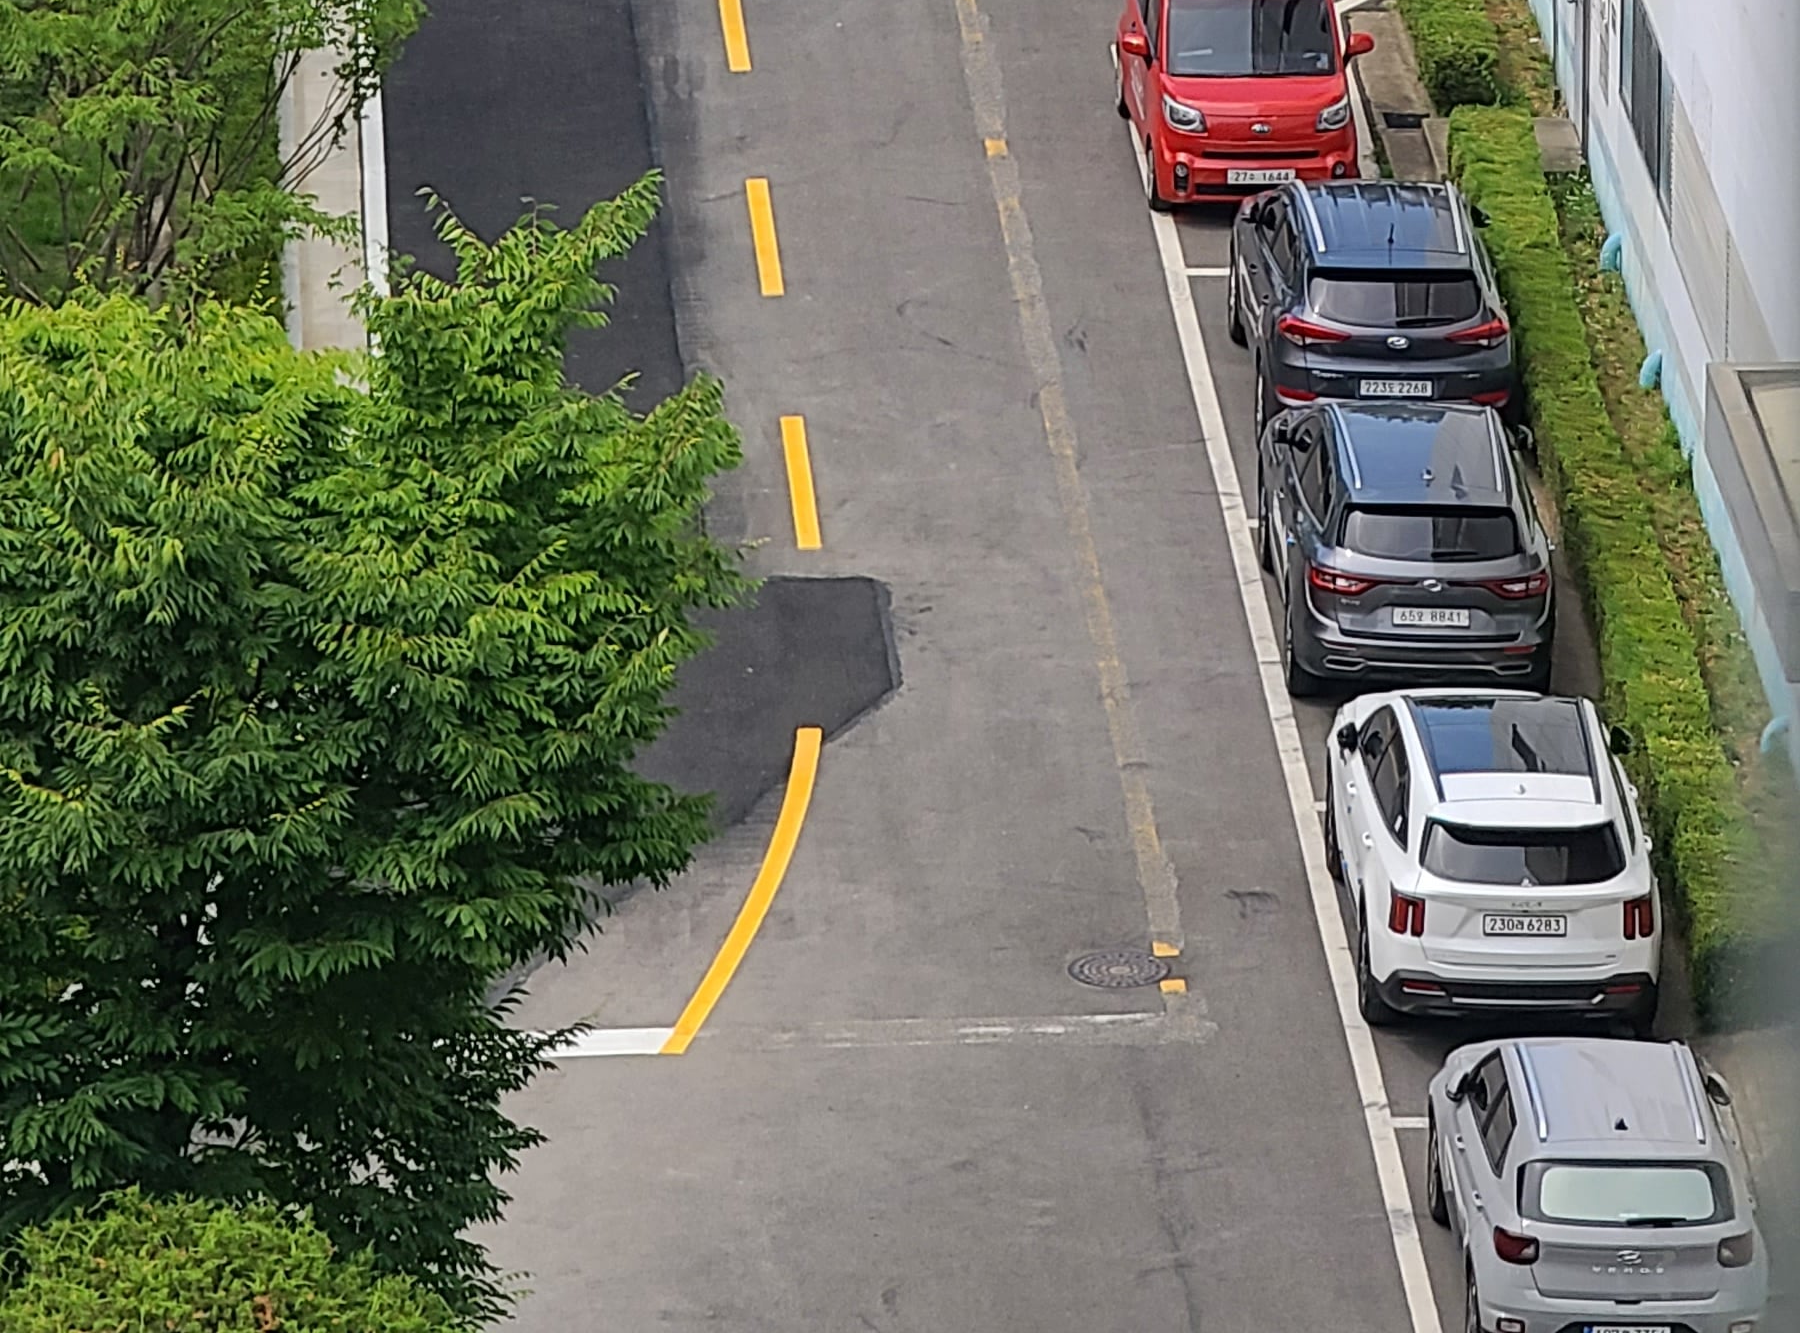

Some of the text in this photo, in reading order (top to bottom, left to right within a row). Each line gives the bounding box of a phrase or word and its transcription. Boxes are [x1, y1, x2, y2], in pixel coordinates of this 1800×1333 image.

[1262, 171, 1289, 181] 1644
[1430, 611, 1461, 623] 8841
[1526, 919, 1561, 932] 6283
